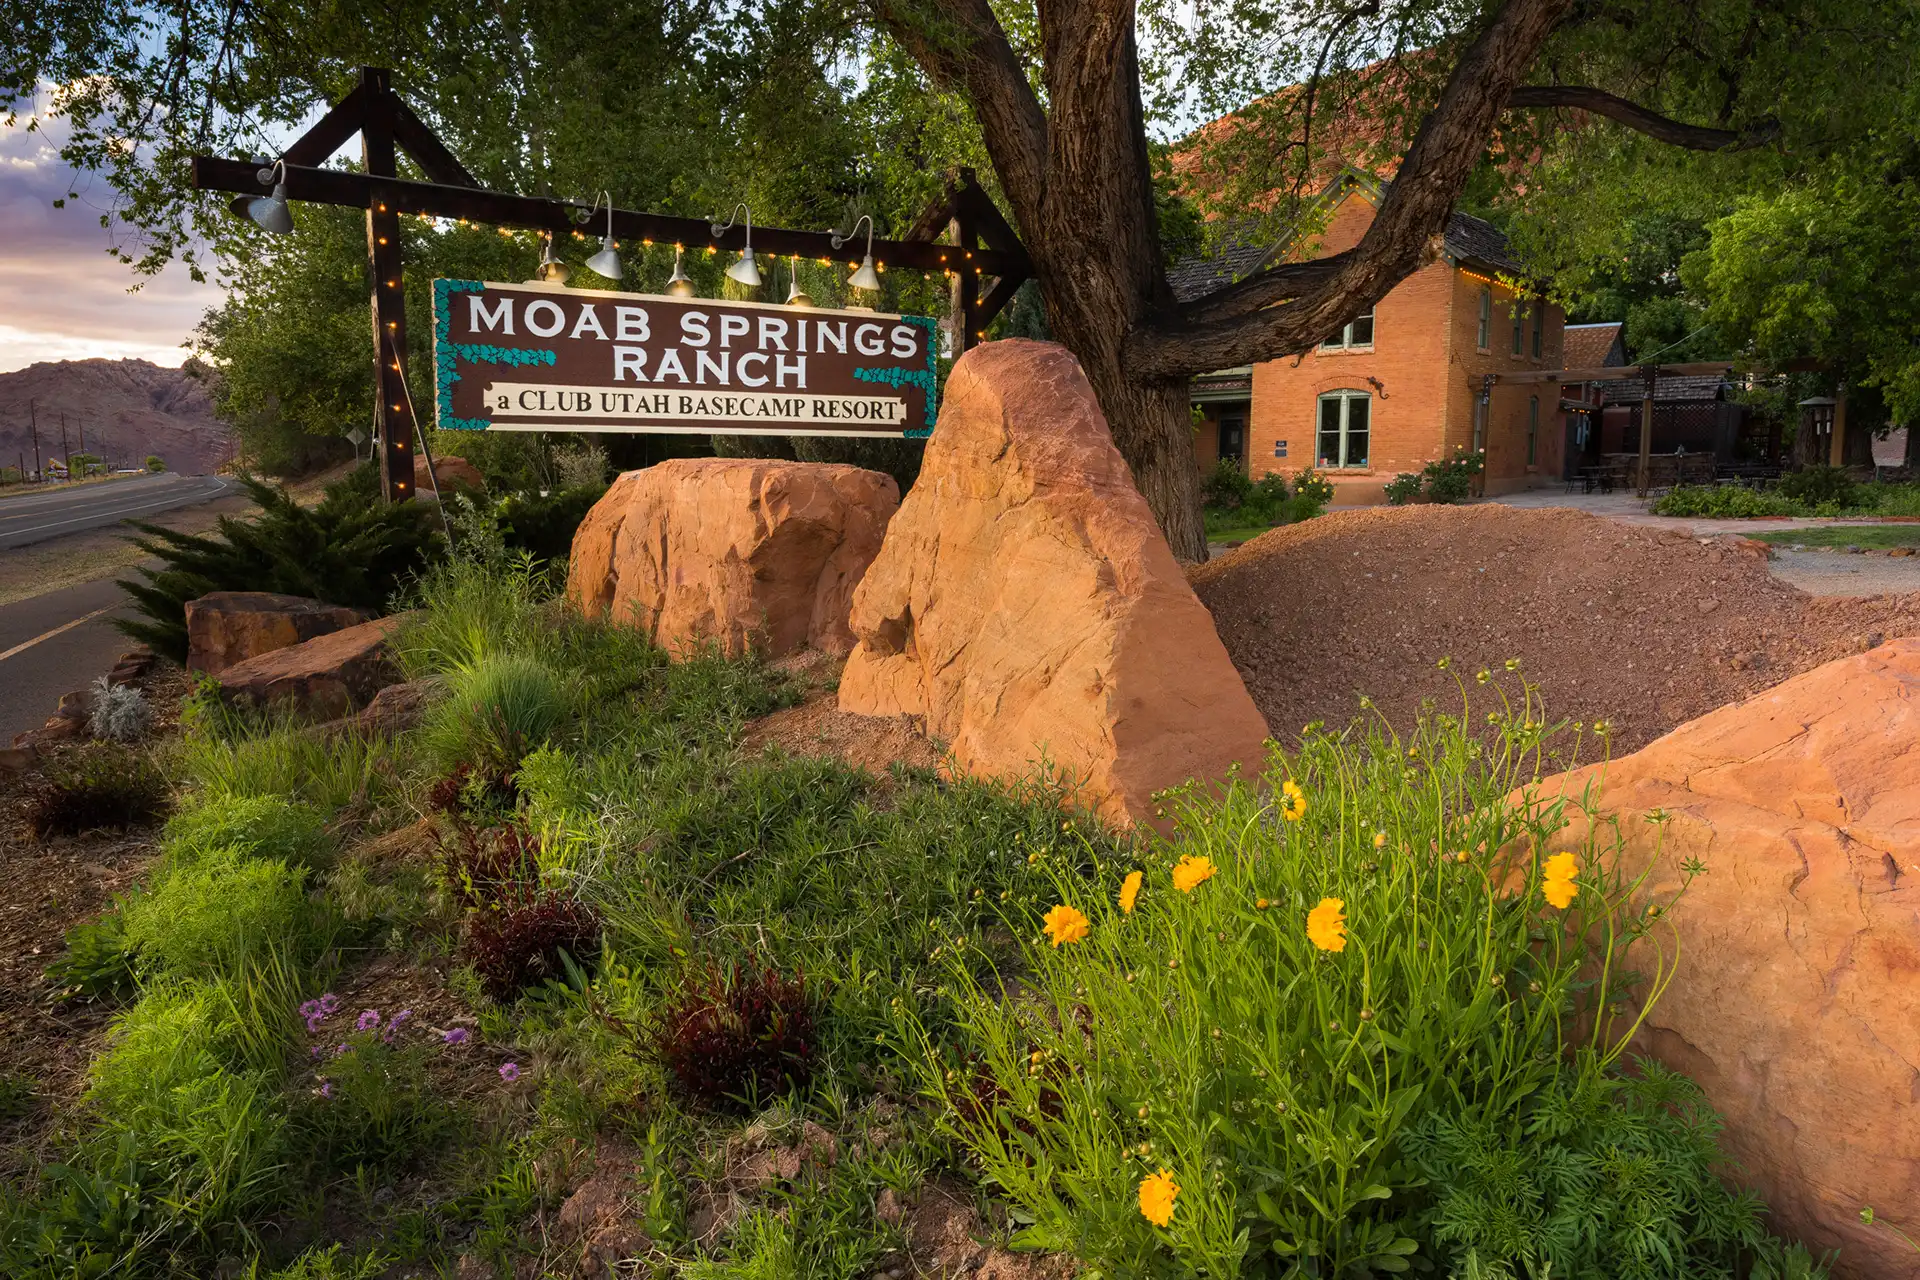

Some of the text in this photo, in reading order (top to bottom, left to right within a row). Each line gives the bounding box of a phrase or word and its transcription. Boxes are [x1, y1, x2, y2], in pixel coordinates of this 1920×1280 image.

[467, 295, 917, 358] MOAB SPRINGS
[612, 345, 807, 388] RANCH
[497, 390, 898, 419] a CLUB UTAH BASECAMP RESORT
